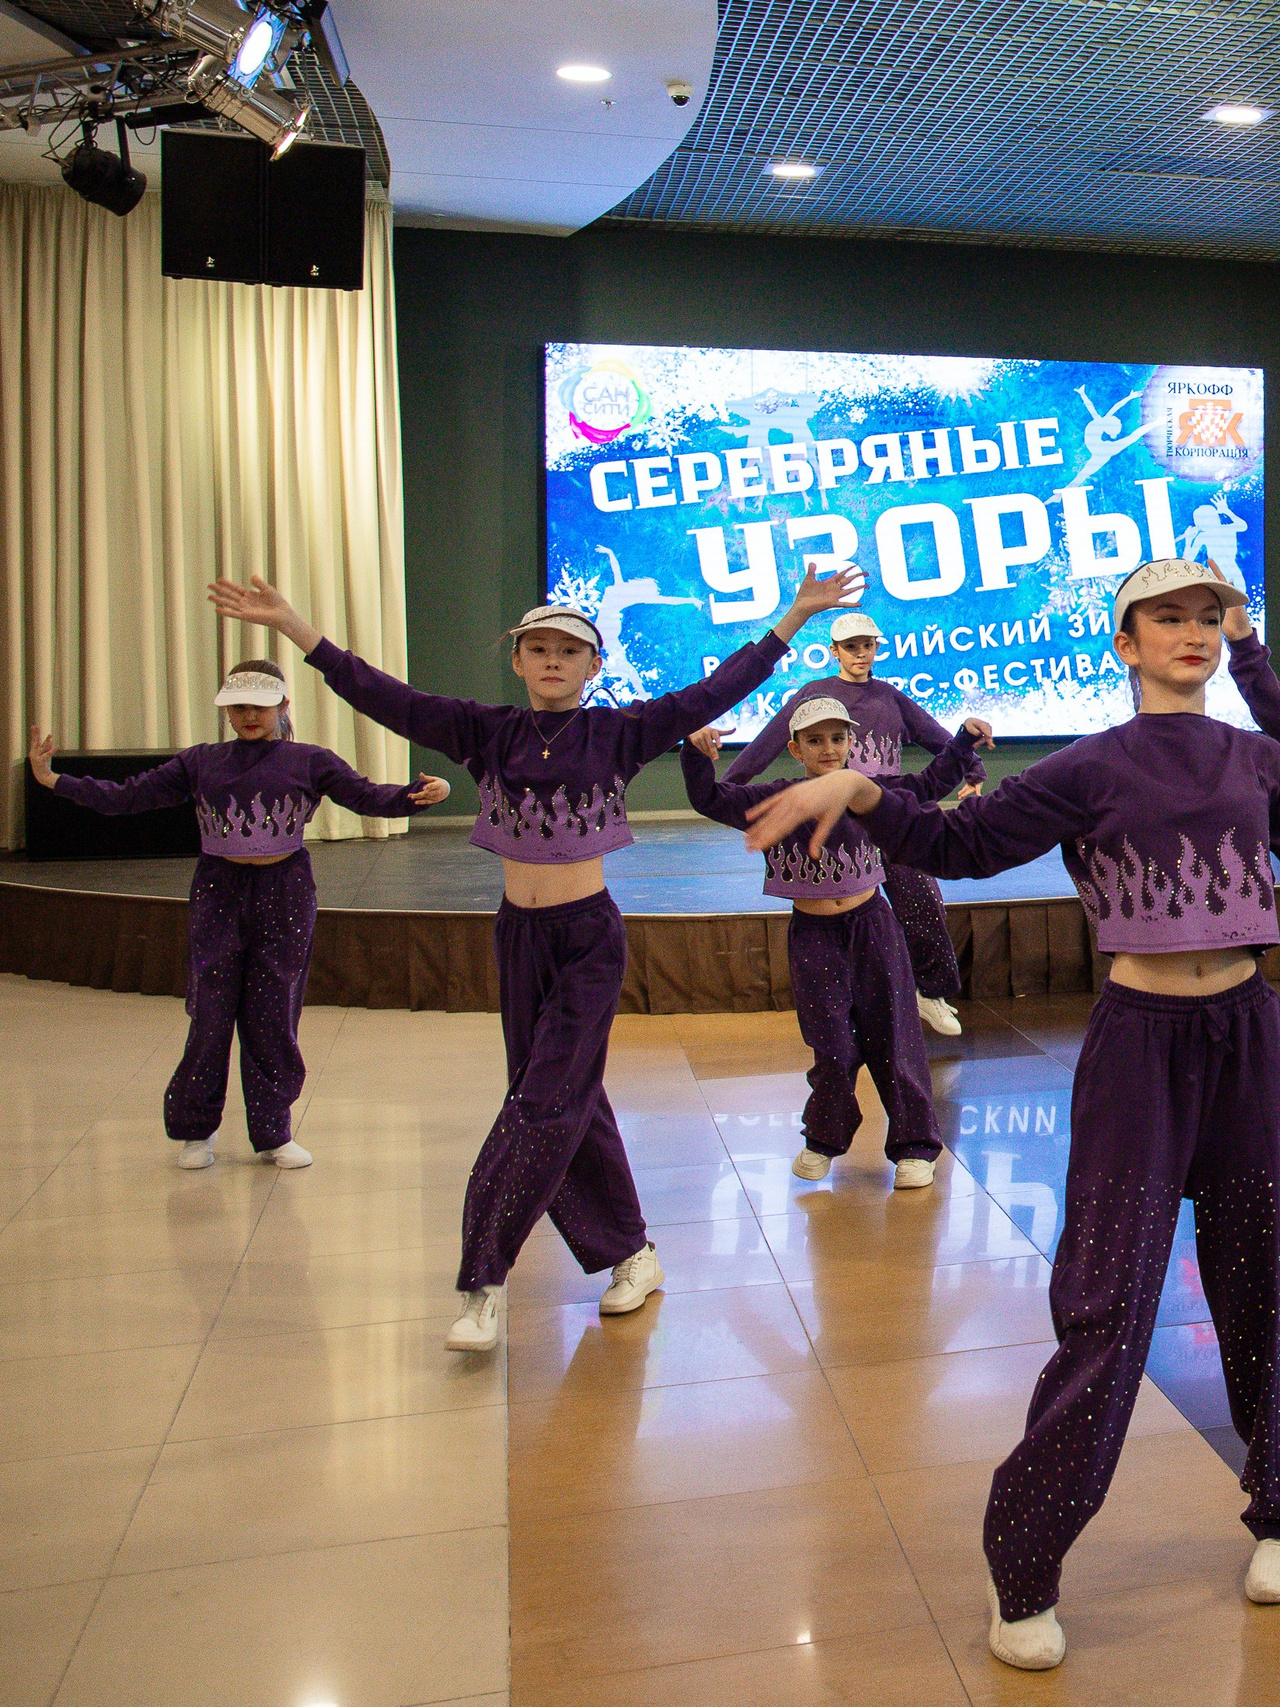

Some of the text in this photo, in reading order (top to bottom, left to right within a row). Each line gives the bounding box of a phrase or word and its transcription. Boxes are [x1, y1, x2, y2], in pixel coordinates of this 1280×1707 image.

[583, 386, 630, 403] САН
[1167, 381, 1234, 396] ЯРКОФФ
[583, 403, 630, 416] СИТИ
[1175, 447, 1249, 459] КОРПОРАЦИЯ
[589, 417, 1064, 513] СЕРЕБРЯНЫЕ
[687, 476, 1178, 626] УЗОРЫ
